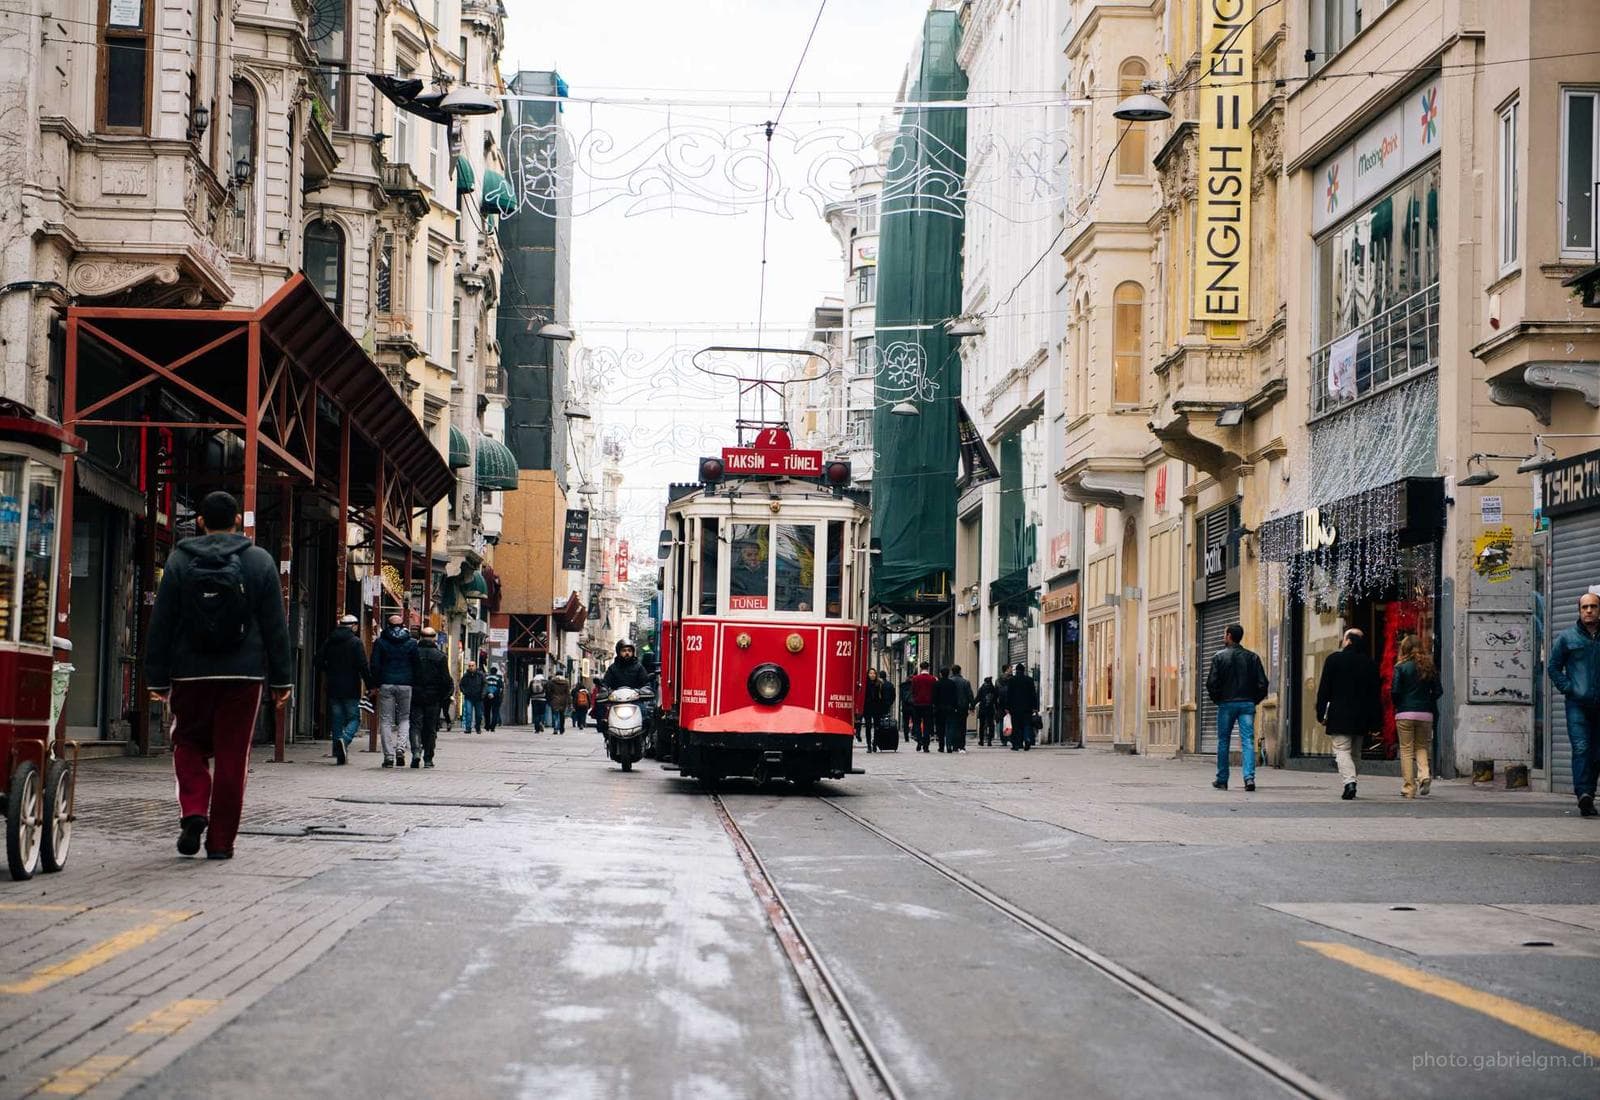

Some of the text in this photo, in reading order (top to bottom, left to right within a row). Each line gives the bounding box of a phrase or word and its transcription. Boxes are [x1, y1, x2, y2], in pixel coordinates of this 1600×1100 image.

[1206, 147, 1242, 313] ENGLISH
[768, 429, 777, 445] 2
[783, 454, 819, 471] TÜNEL
[732, 597, 766, 609] TÜNEL
[686, 635, 702, 651] 223
[836, 640, 852, 657] 223
